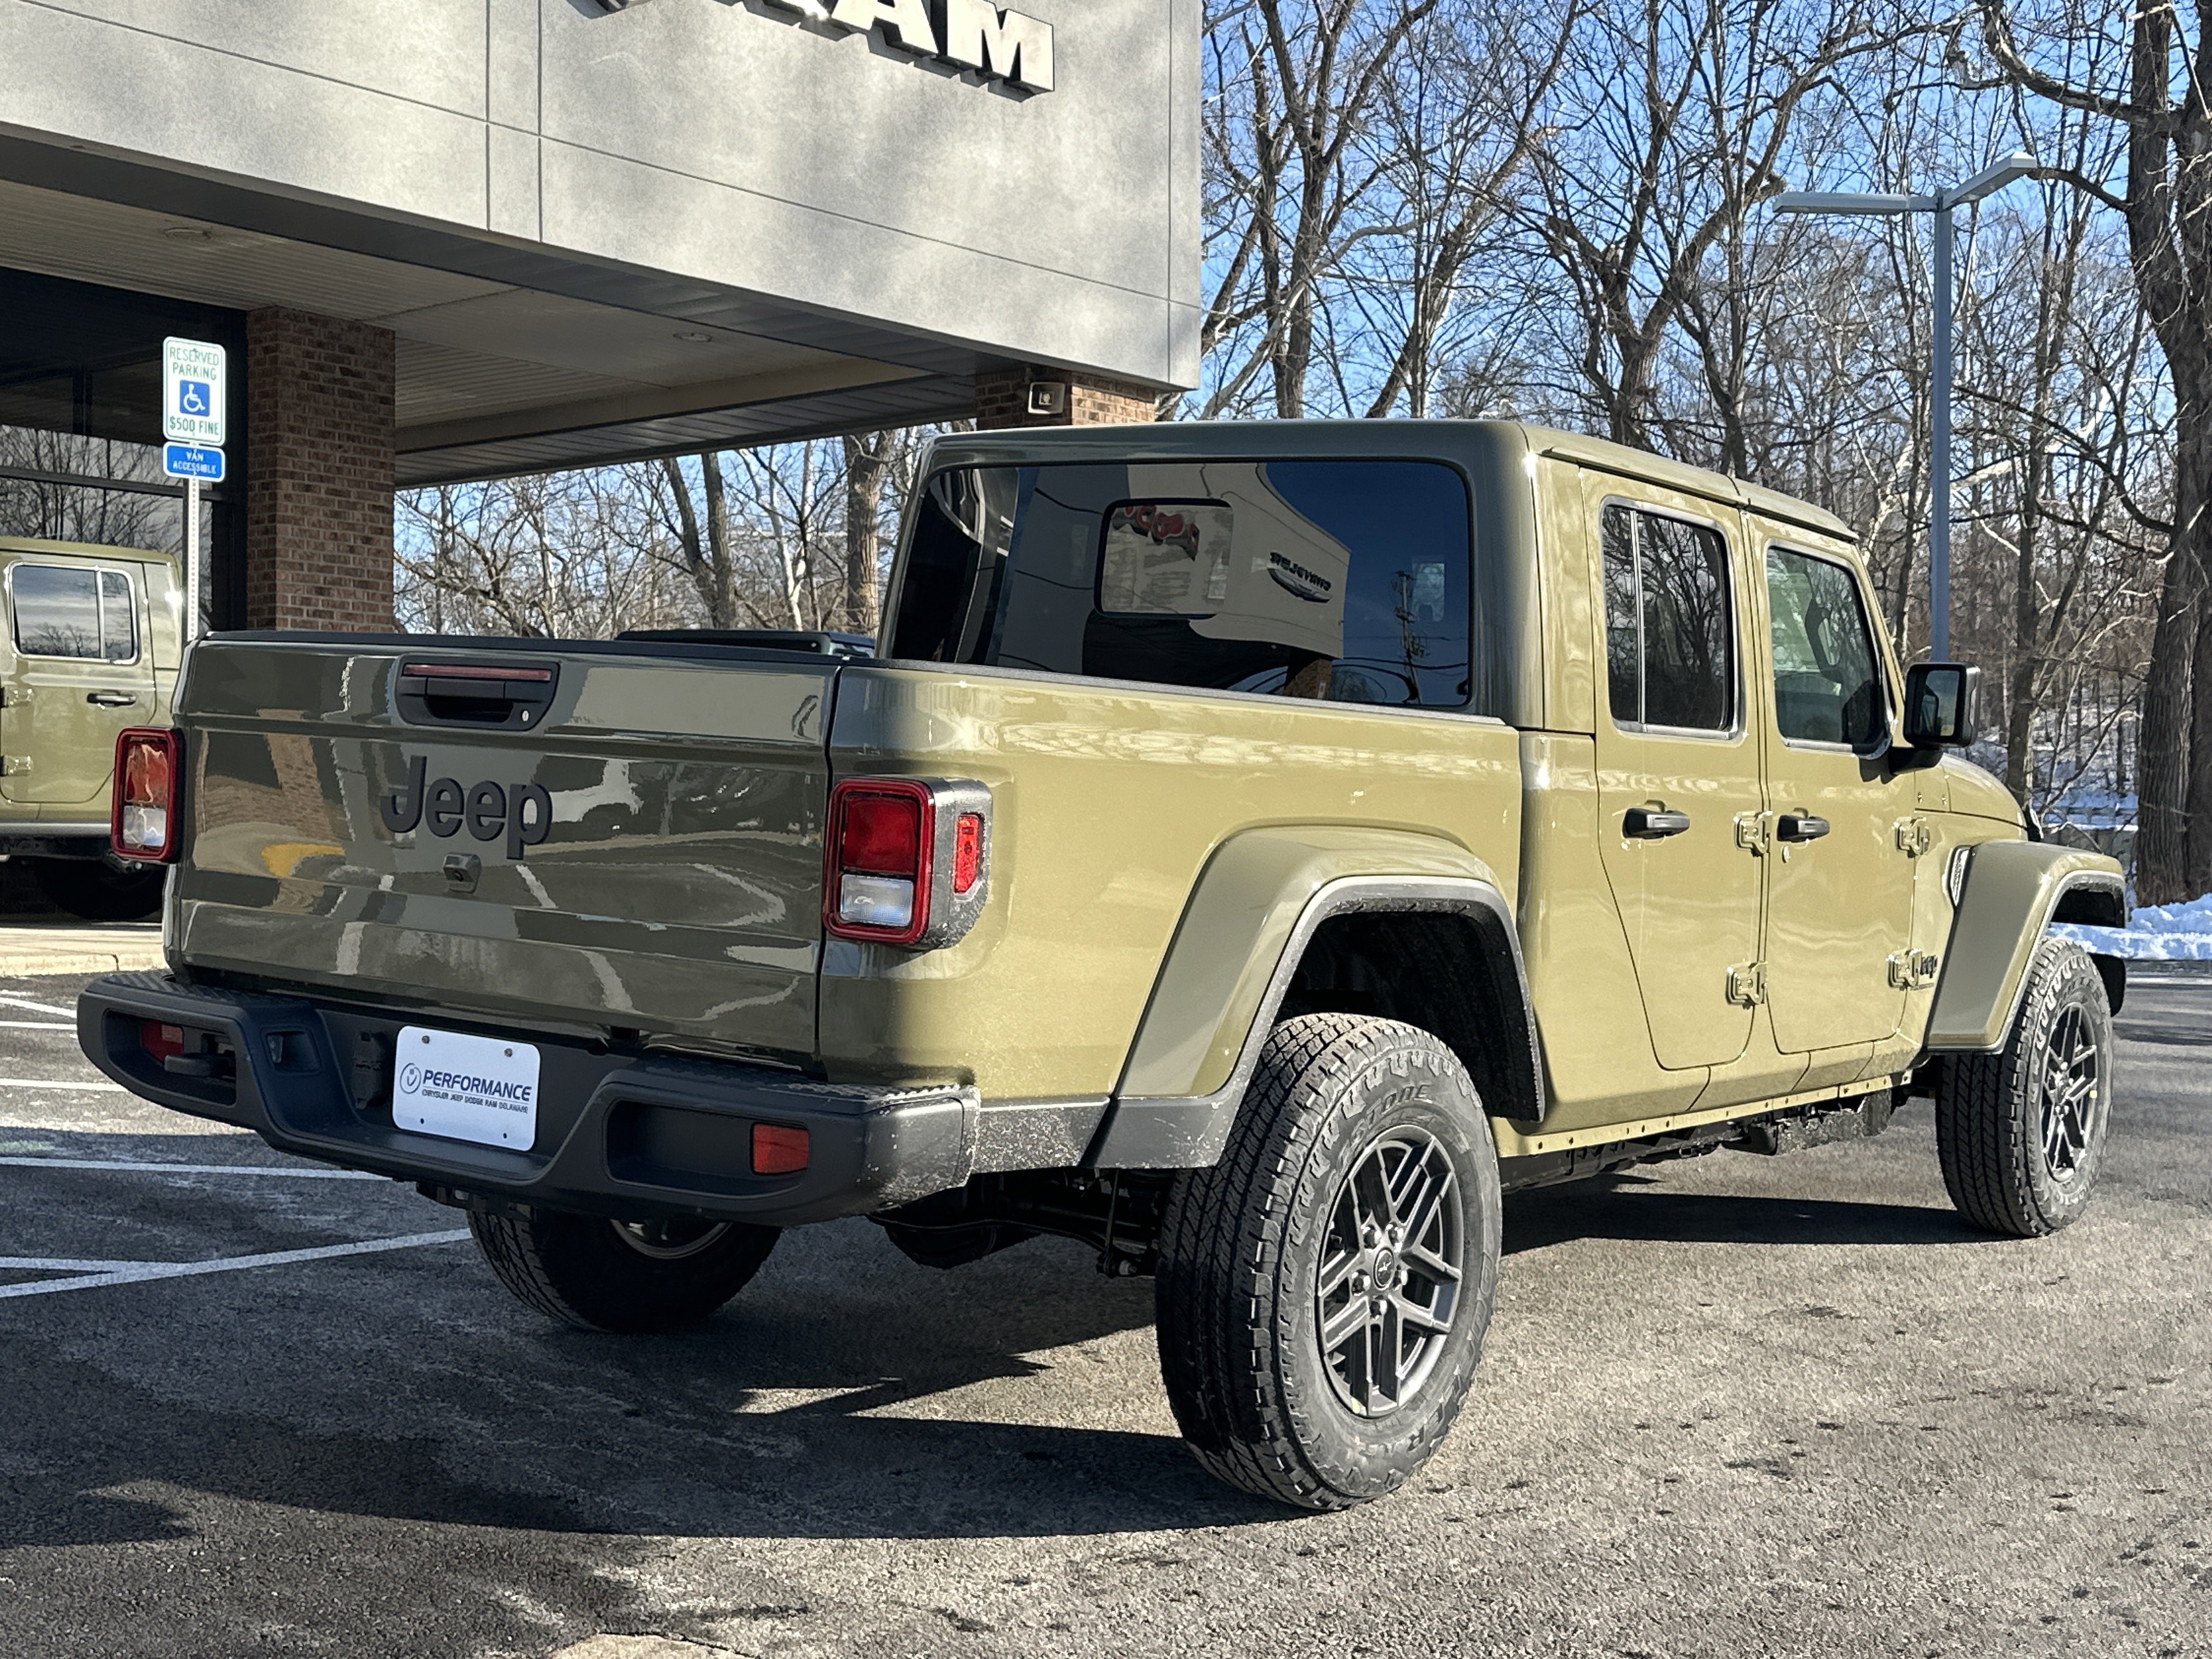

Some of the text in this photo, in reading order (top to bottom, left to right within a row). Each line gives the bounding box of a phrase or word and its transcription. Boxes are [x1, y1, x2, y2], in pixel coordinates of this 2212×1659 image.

[765, 0, 1054, 94] AM
[170, 347, 219, 365] RESERVED
[173, 362, 216, 381] PARKING
[170, 415, 219, 435] $500 FINE
[186, 451, 204, 462] VAN
[173, 461, 217, 475] ACCESSIBLE
[381, 755, 552, 860] Jeep
[422, 1069, 532, 1102] PERFORMANCE
[484, 1099, 498, 1108] RAM
